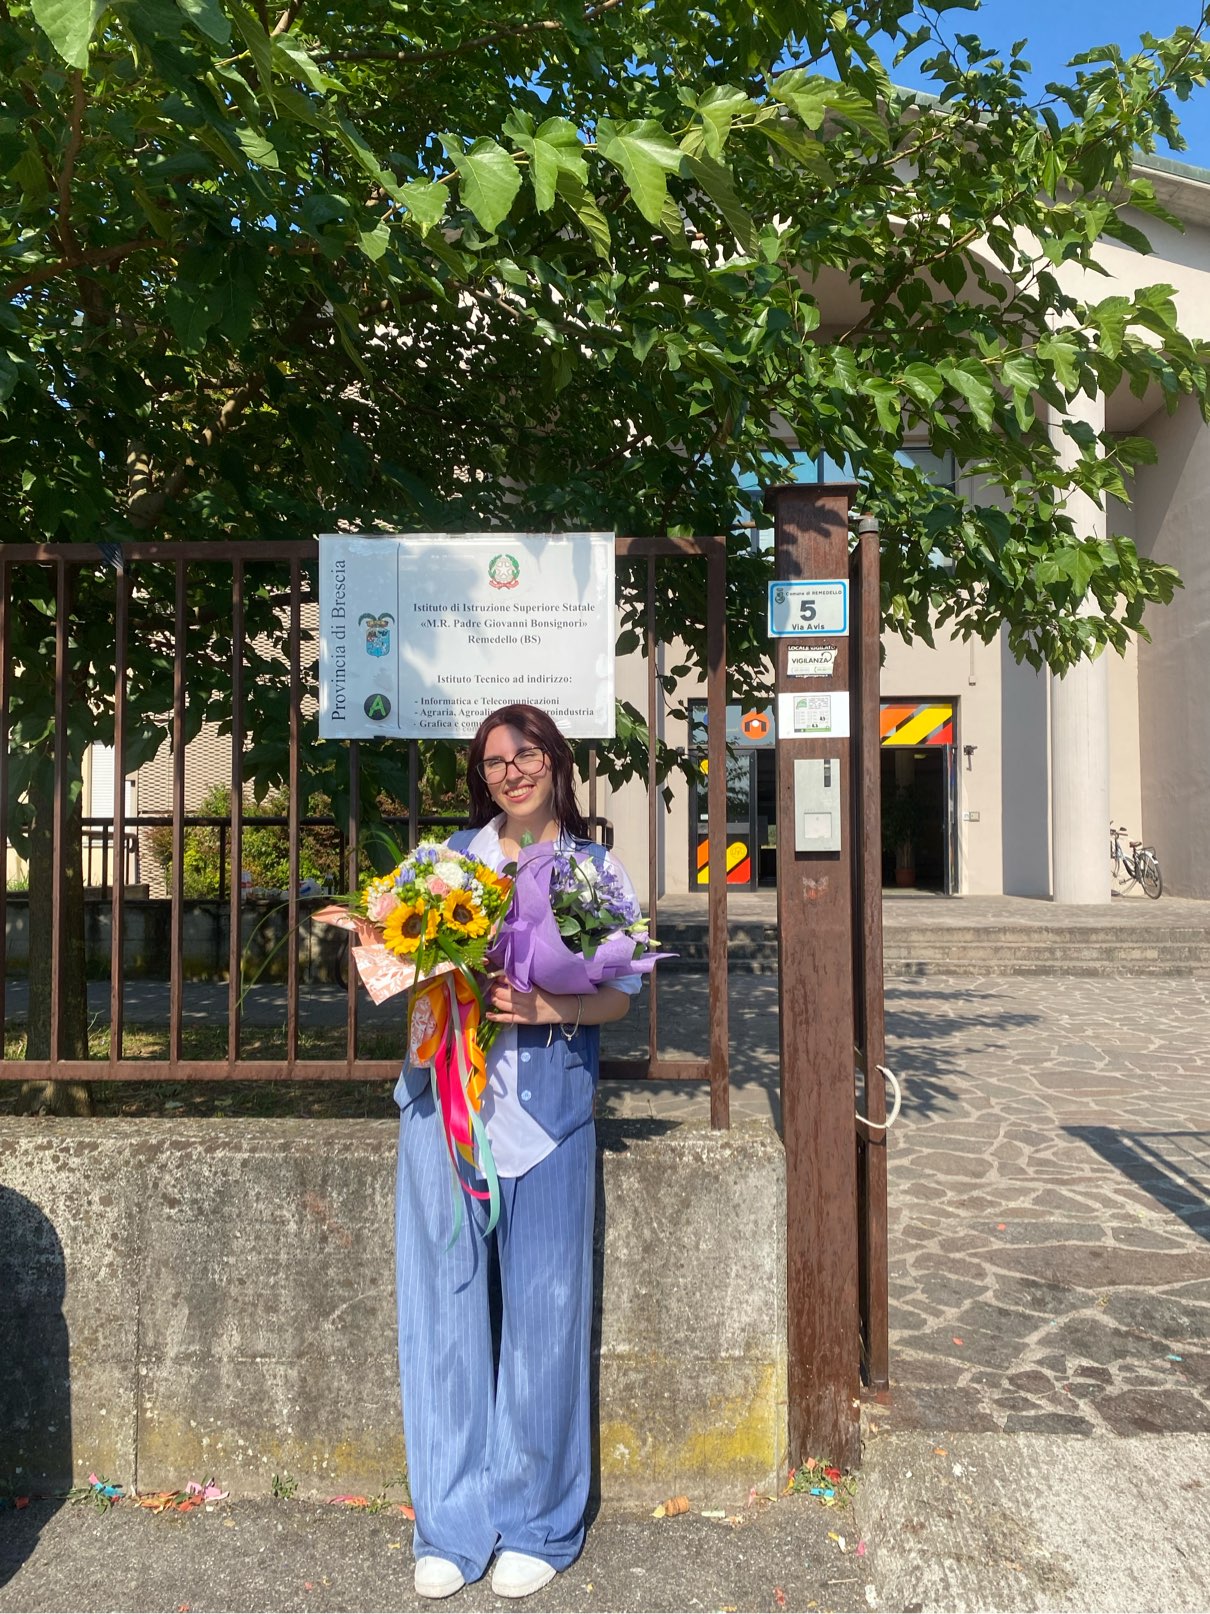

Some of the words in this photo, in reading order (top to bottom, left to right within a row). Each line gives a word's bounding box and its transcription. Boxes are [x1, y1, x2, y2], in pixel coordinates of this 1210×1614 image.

[331, 559, 346, 619] Brescia
[413, 603, 448, 612] Istituto
[450, 603, 460, 612] di
[463, 603, 511, 612] Istruzione
[513, 603, 560, 614] Superiore
[562, 603, 595, 612] Statale
[799, 599, 817, 622] 5
[453, 619, 482, 628] Padre
[484, 619, 528, 628] Giovanni
[531, 619, 588, 629] Bonsignori»
[792, 623, 805, 631] Via
[806, 623, 825, 631] Avis
[331, 625, 346, 640] di
[468, 635, 518, 644] Remedello
[520, 635, 541, 645] (BS)
[331, 646, 346, 721] Provincia
[437, 674, 472, 684] Istituto
[475, 674, 510, 684] Tecnico
[512, 674, 524, 684] ad
[527, 674, 572, 684] indirizzo:
[421, 697, 471, 705] Informatica
[481, 696, 560, 705] Telecomunicazioni
[420, 708, 457, 718] Agraria,
[544, 707, 594, 716] roindustria
[420, 720, 452, 728] Grafica
